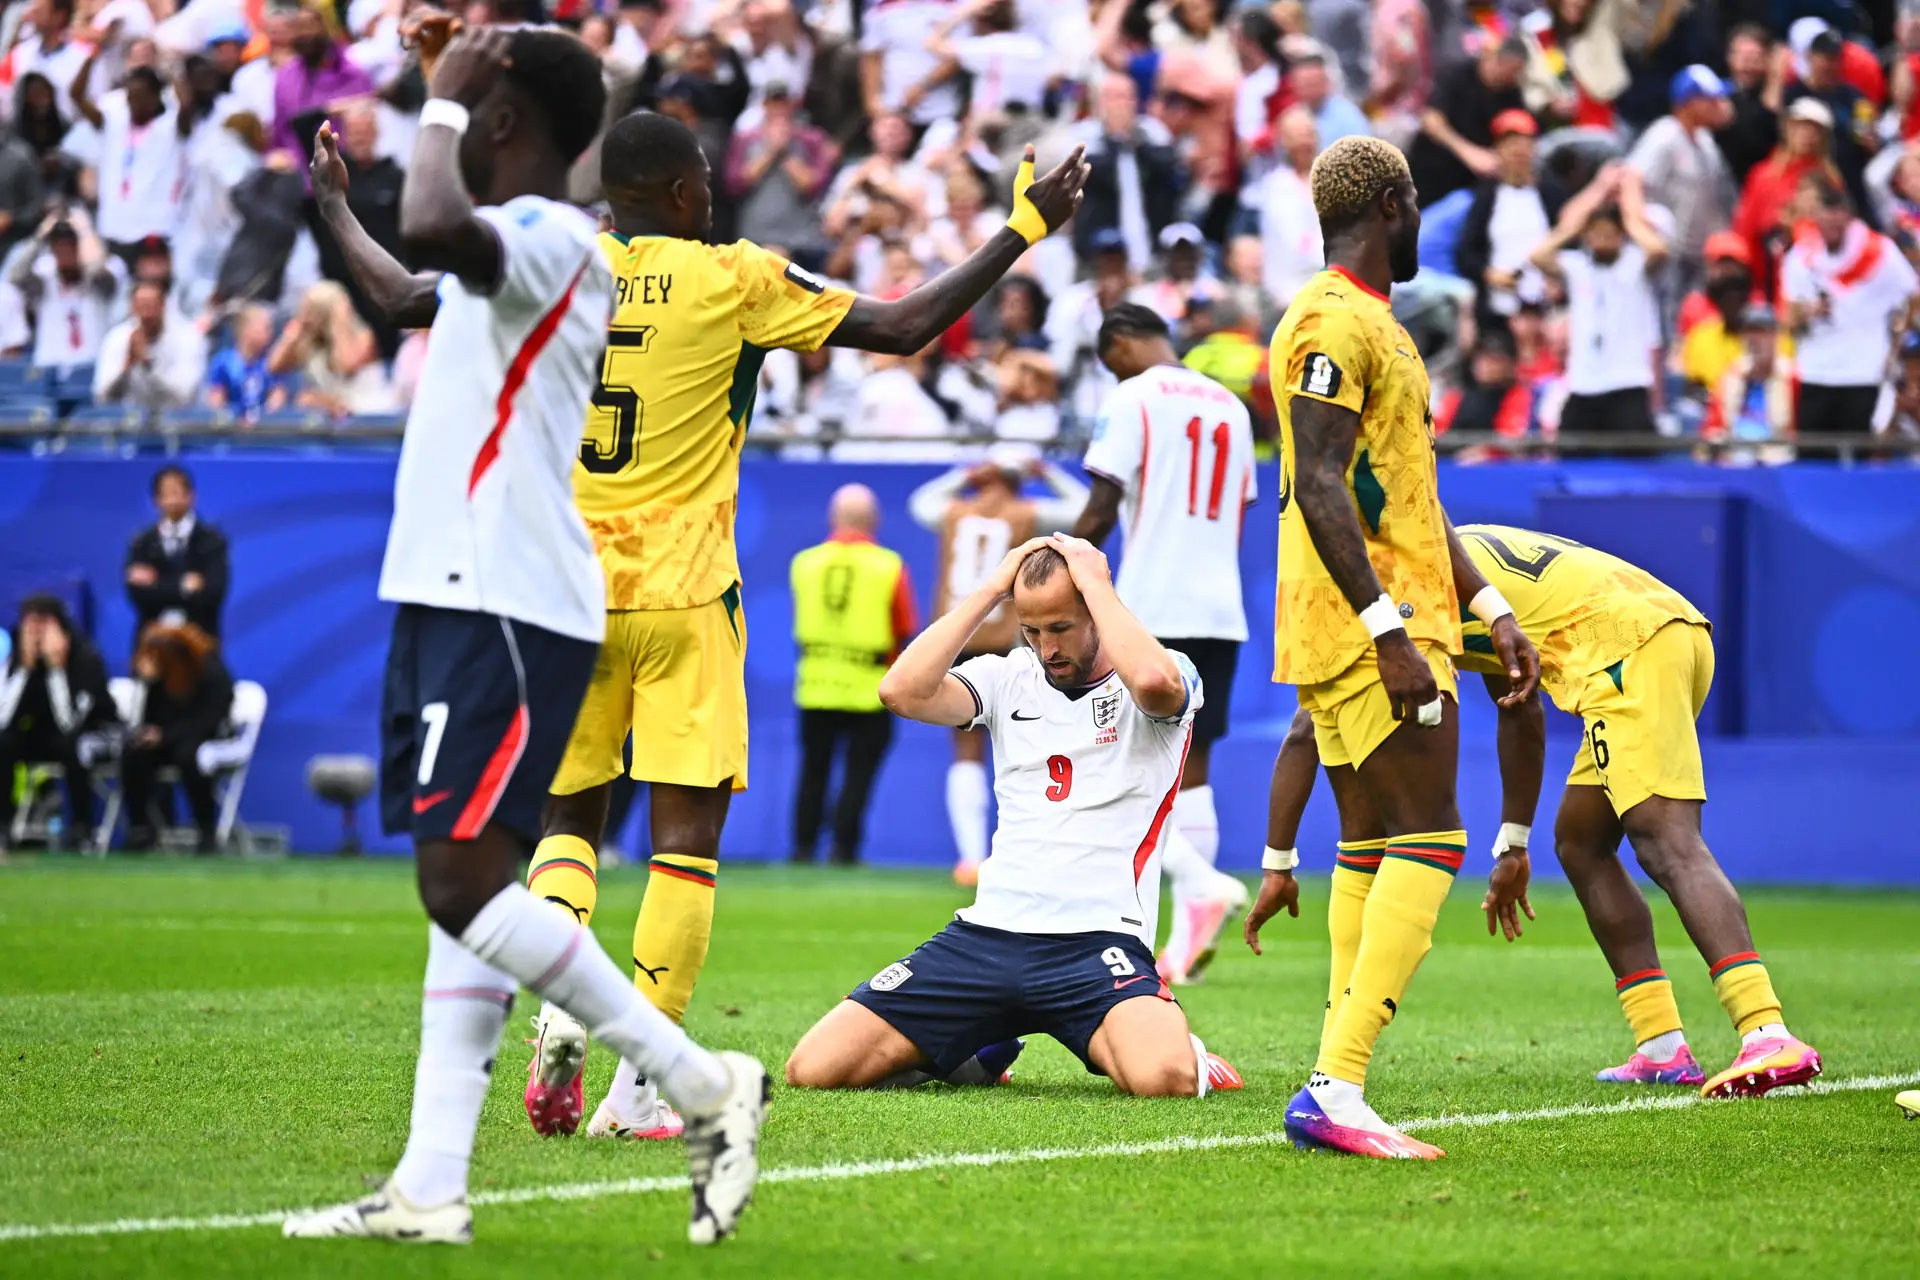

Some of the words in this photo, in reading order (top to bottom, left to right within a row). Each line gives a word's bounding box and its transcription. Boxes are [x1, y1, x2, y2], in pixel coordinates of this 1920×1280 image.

[577, 324, 658, 476] 5
[1186, 416, 1230, 521] 11
[1456, 529, 1585, 583] 2
[1585, 719, 1610, 771] 6
[1045, 754, 1073, 802] 9
[1101, 946, 1136, 976] 9
